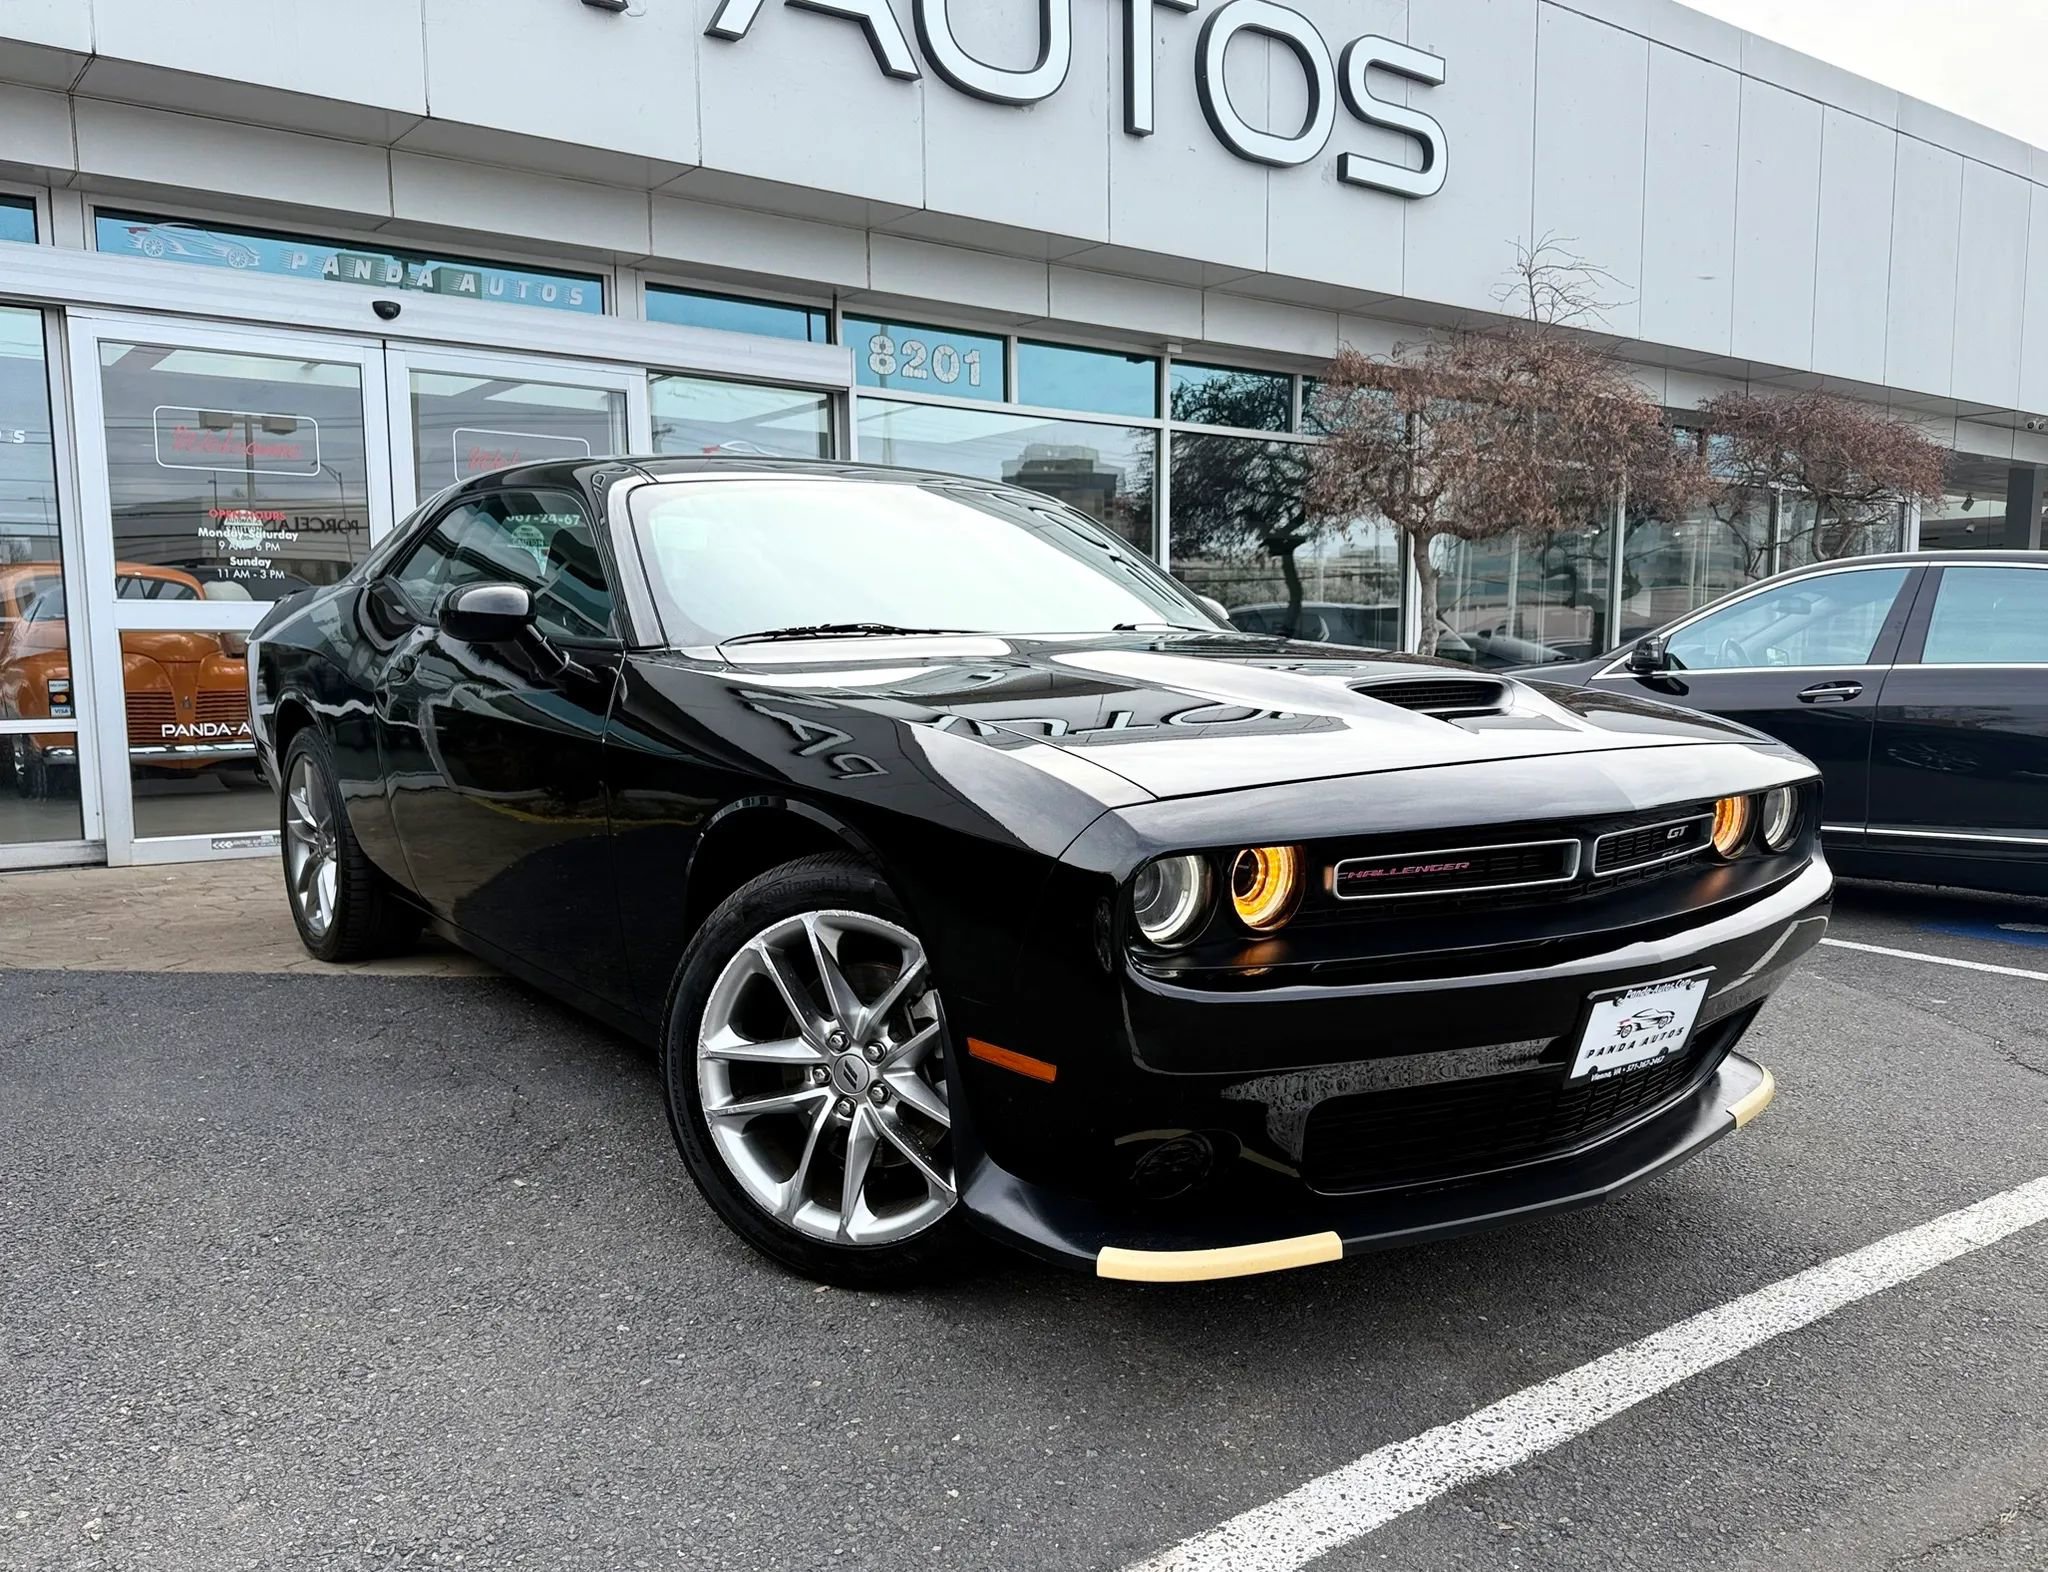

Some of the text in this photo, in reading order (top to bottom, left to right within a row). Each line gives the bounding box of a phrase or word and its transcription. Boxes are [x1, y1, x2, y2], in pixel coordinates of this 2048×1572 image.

[286, 250, 584, 306] PANDA AUTOS
[868, 335, 981, 387] 8201
[198, 527, 299, 542] Monday-Saturday
[218, 540, 226, 550] 9
[265, 542, 281, 552] PM
[229, 556, 272, 569] Sunday
[217, 568, 230, 578] 11
[233, 569, 250, 579] AM
[260, 569, 267, 579] 3
[269, 570, 285, 580] PM
[1666, 825, 1689, 839] GT
[1586, 1026, 1685, 1059] PANDA AUTOS
